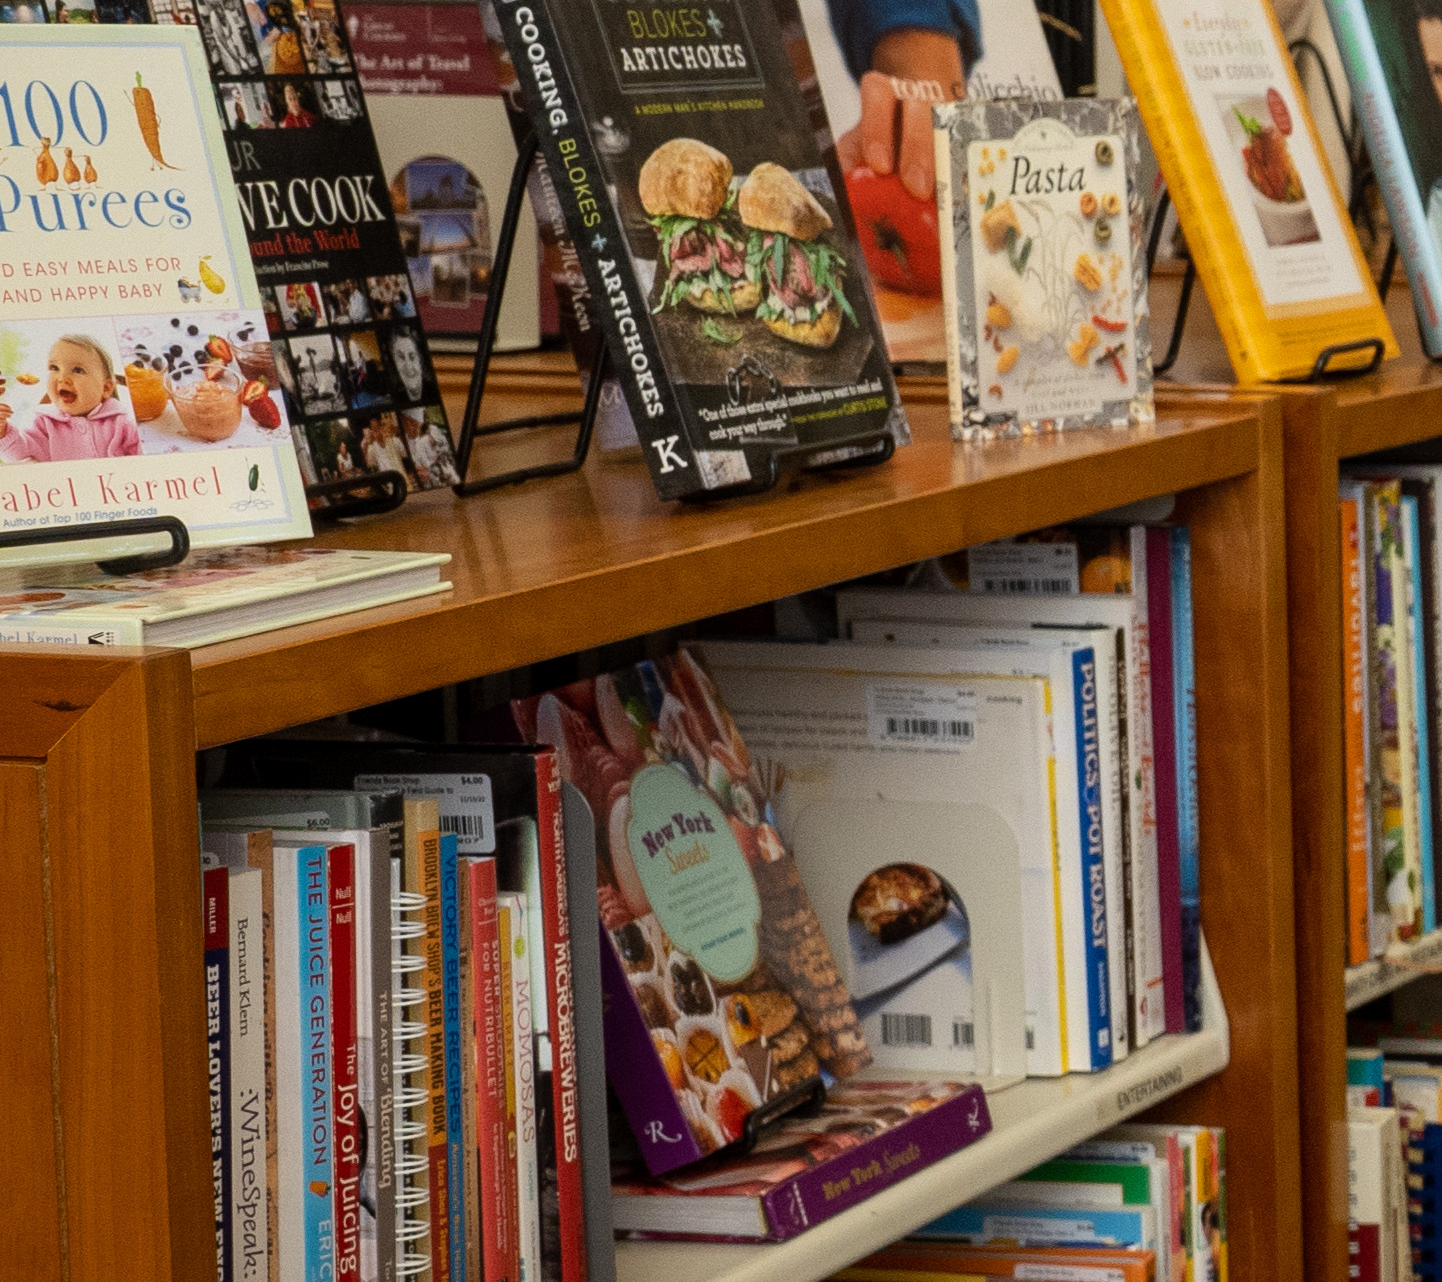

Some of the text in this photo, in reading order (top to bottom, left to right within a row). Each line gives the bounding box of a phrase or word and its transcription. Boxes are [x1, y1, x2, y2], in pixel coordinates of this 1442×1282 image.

[620, 44, 746, 72] ARTICHOKES
[889, 76, 946, 102] tom
[0, 80, 108, 147] 100
[288, 175, 387, 229] COOK
[1009, 155, 1088, 197] Pasta
[315, 228, 360, 251] World
[516, 6, 664, 418] COOKING, BLOKES ARTICHOKES
[2, 281, 163, 305] AND HAPPY BABY
[23, 255, 182, 277] EASY MEALS FOR
[652, 435, 688, 474] K
[2, 465, 223, 514] abel Karmel
[640, 809, 716, 859] New York
[1078, 661, 1106, 950] POLITICS ROAST
[237, 918, 250, 987] Bernard
[422, 838, 447, 1135] BROOKLYN MAKING BOOK
[207, 965, 222, 1035] BEER
[305, 855, 328, 1165] THE JUICE GENERATION
[444, 856, 462, 1135] VICTORY RECIPES
[483, 979, 497, 1099] NUTRIBULLET
[514, 979, 536, 1144] MOMOSAS
[553, 941, 578, 1163] MICROBREWERIES
[337, 1044, 361, 1275] The Joy Juicing
[377, 1087, 396, 1189] Blending
[317, 1219, 334, 1282] ERIC
